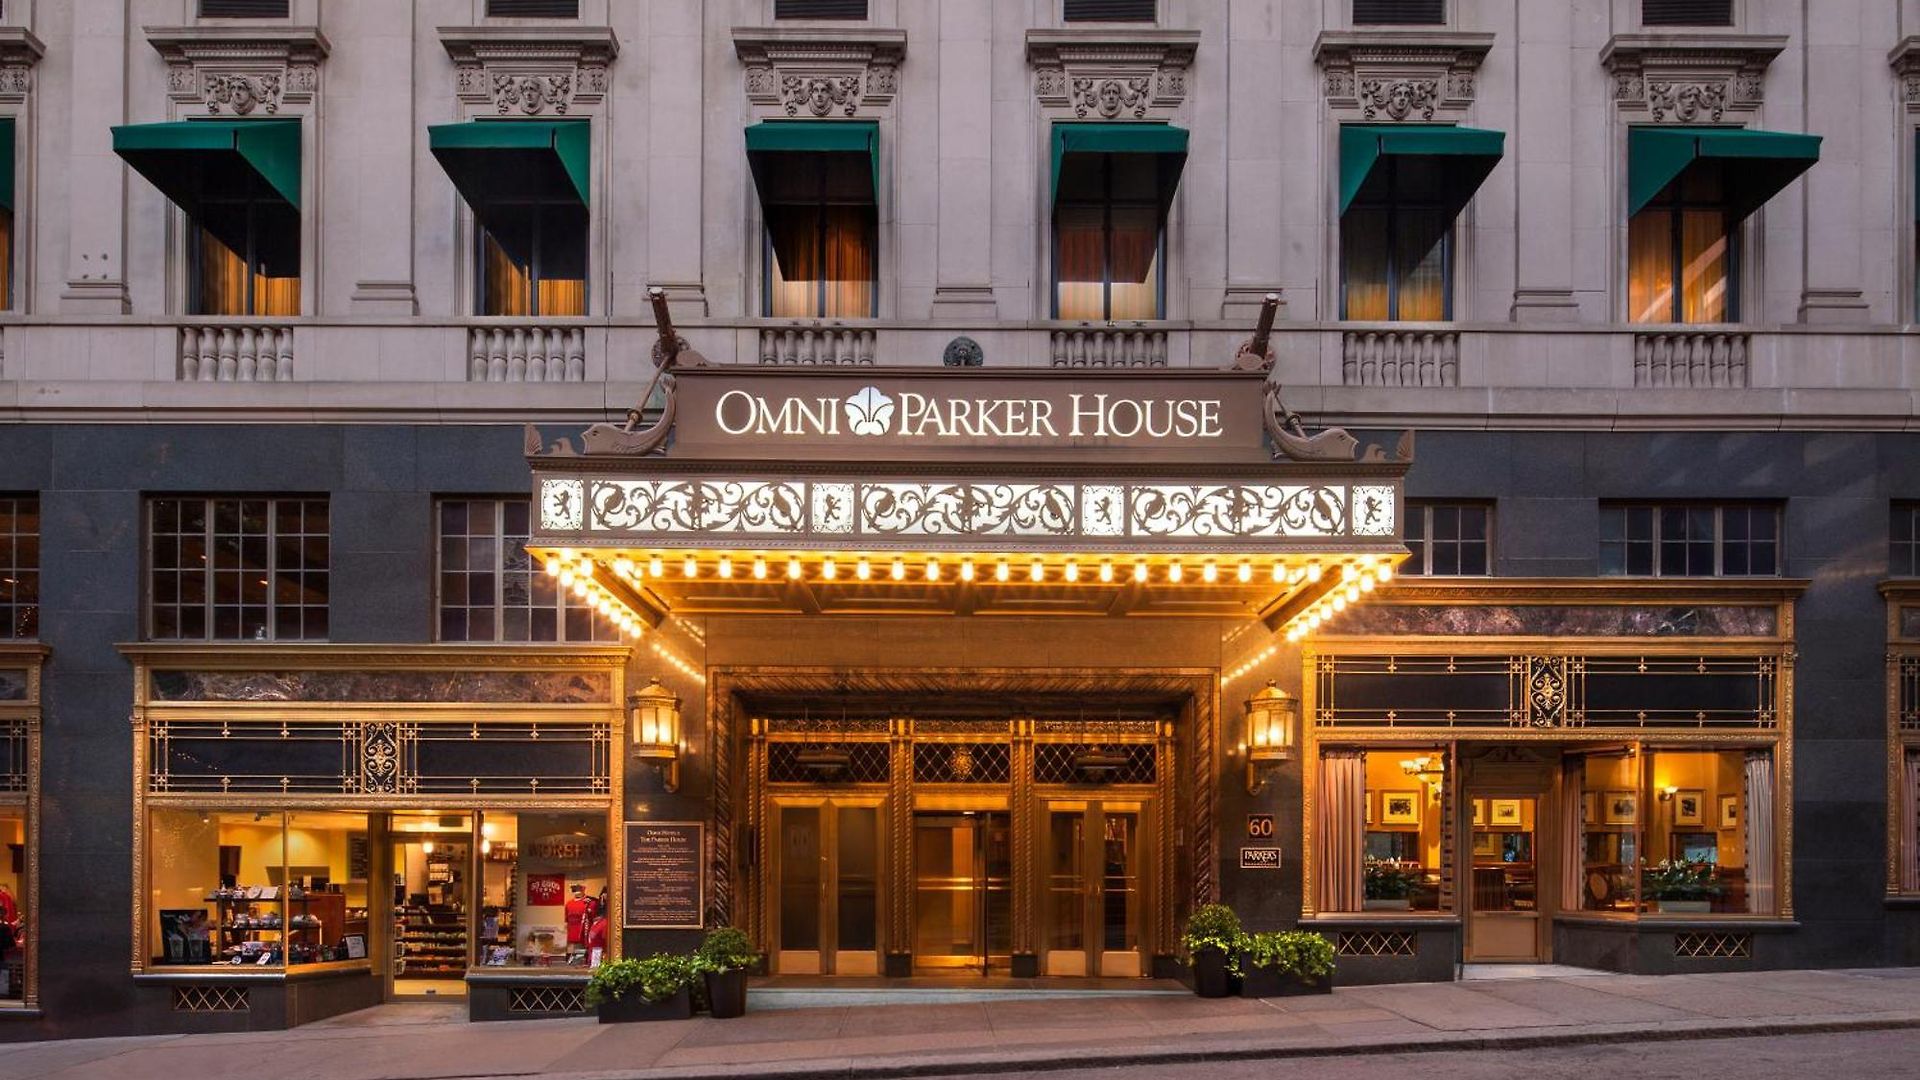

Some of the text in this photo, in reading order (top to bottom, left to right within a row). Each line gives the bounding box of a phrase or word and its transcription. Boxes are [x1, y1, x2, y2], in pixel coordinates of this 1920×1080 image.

[715, 390, 1223, 438] OMNI PARKER HOUSE
[1250, 819, 1272, 836] 60
